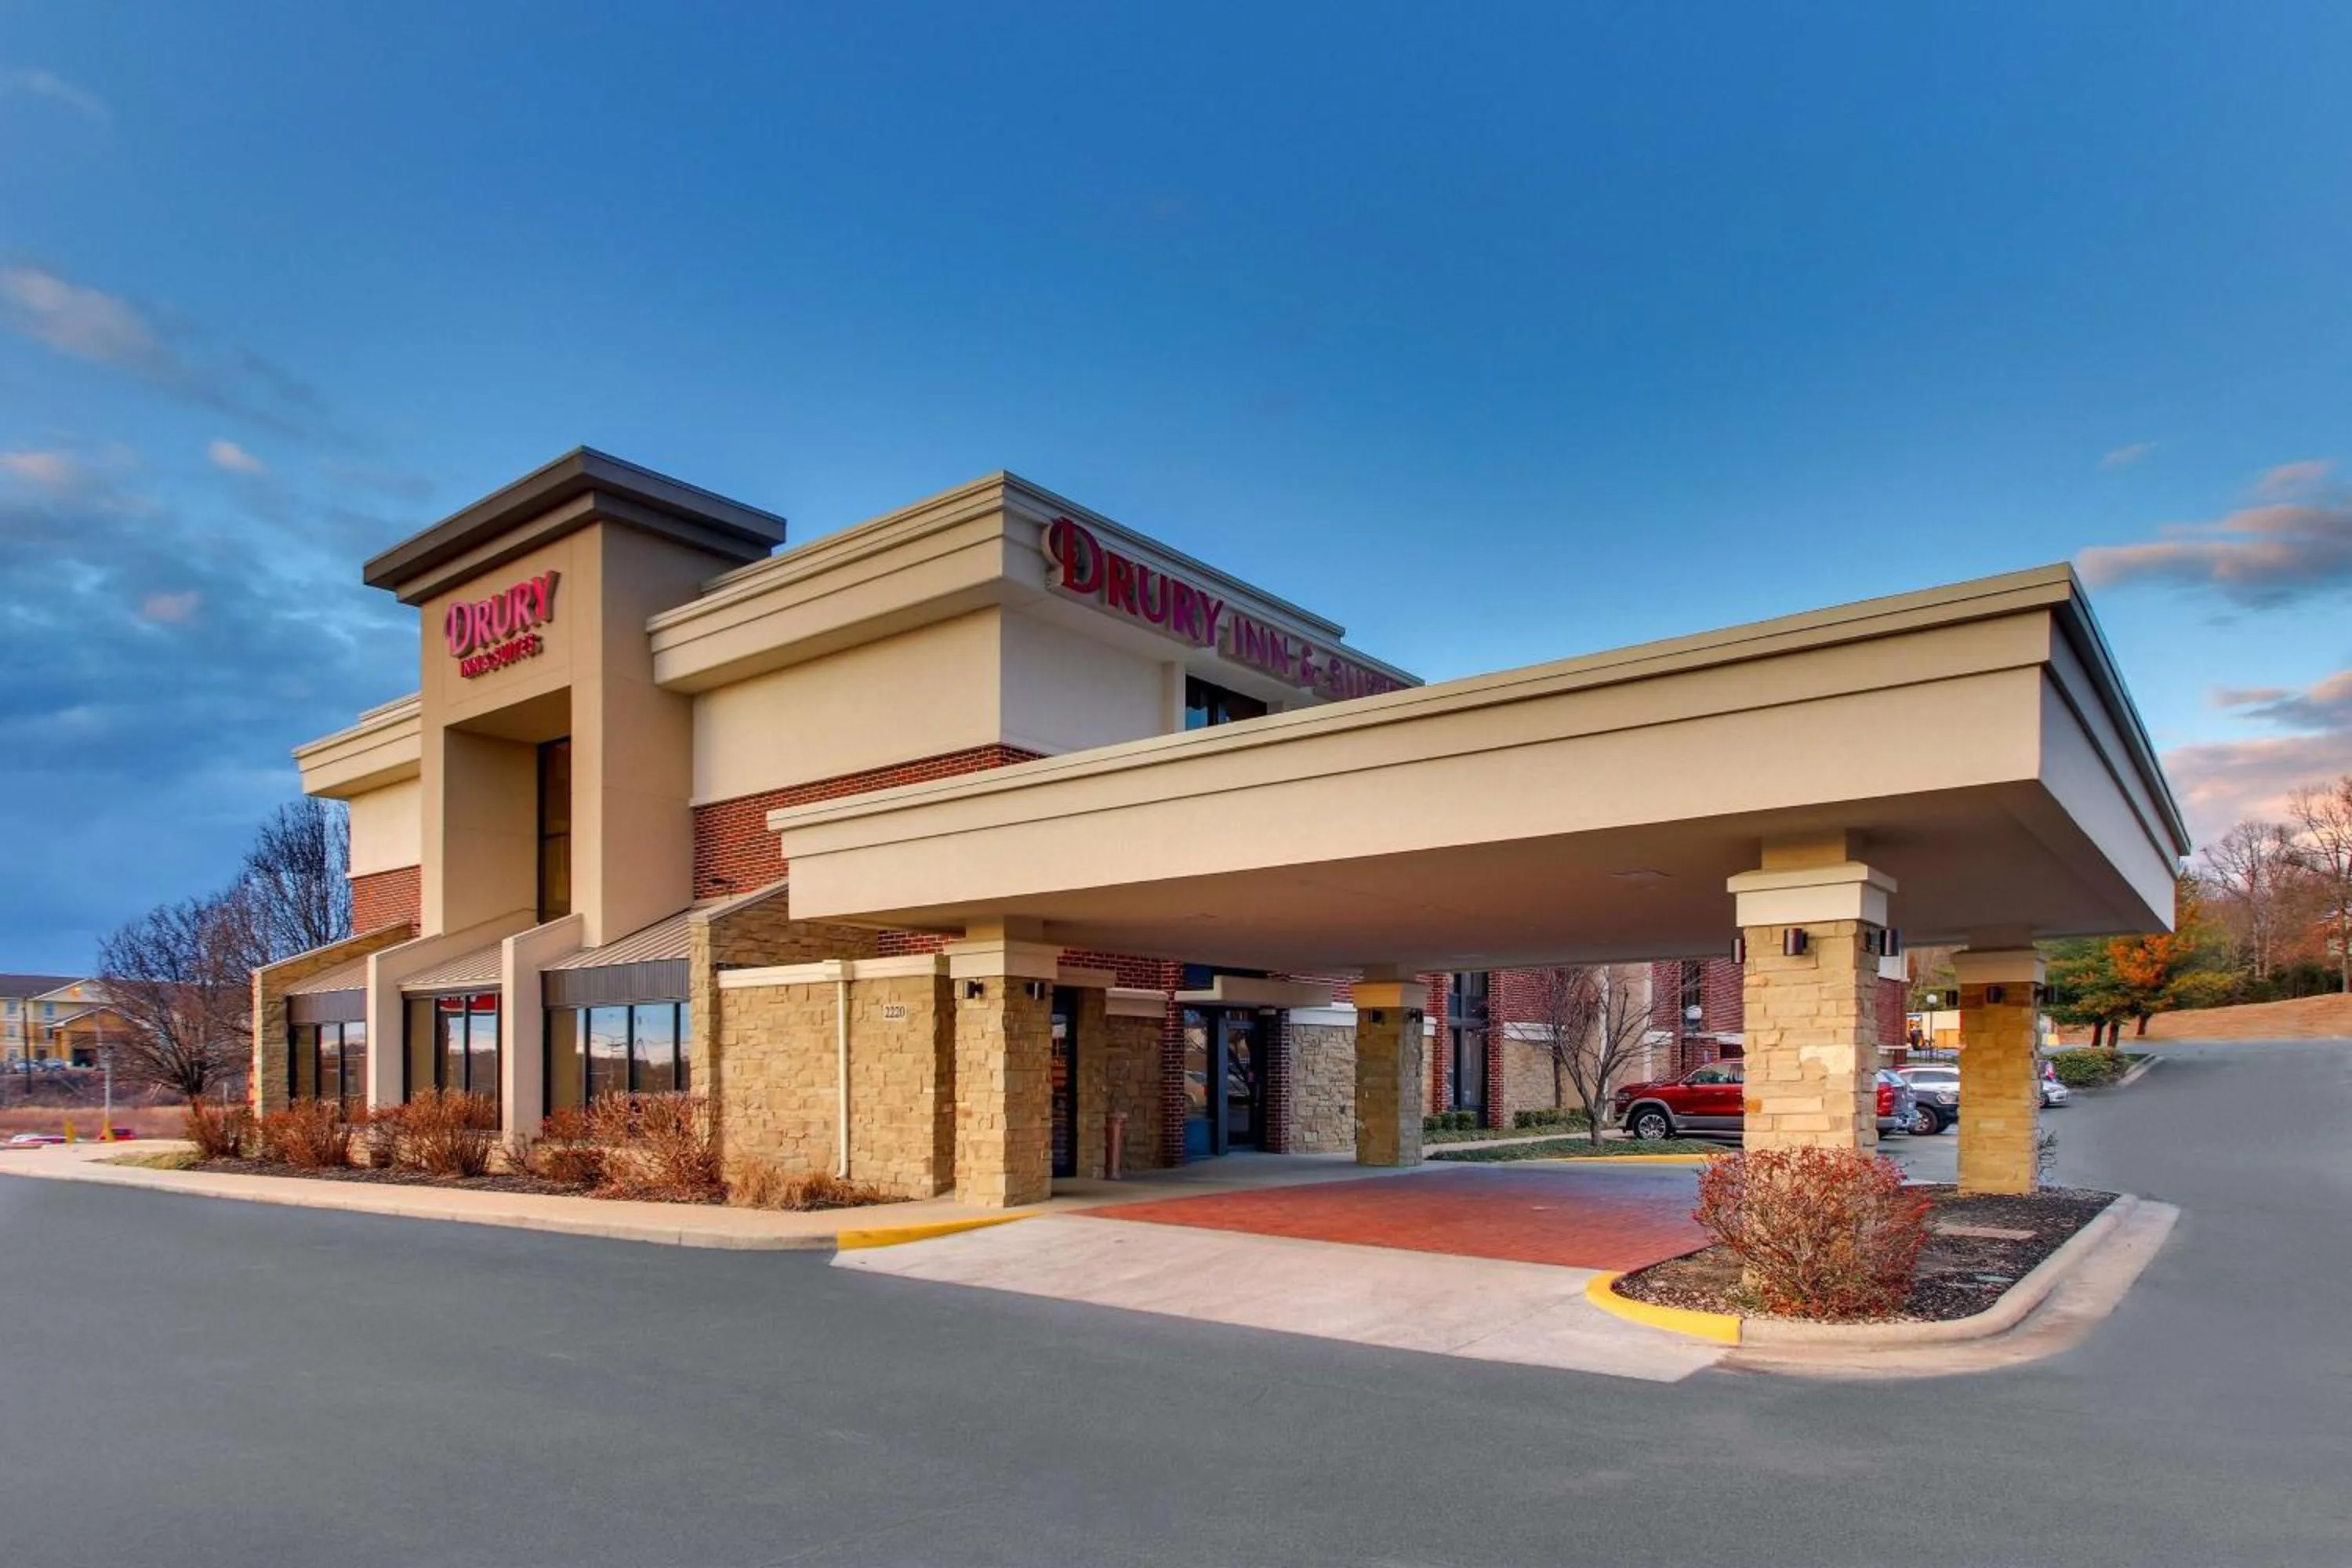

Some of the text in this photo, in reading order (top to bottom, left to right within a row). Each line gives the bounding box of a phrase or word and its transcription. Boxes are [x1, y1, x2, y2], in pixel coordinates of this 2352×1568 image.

[447, 571, 558, 656] DRURY
[1047, 517, 1224, 647] DRURY
[1232, 615, 1289, 674] INN
[1298, 643, 1317, 687] &
[885, 1006, 905, 1018] 2220
